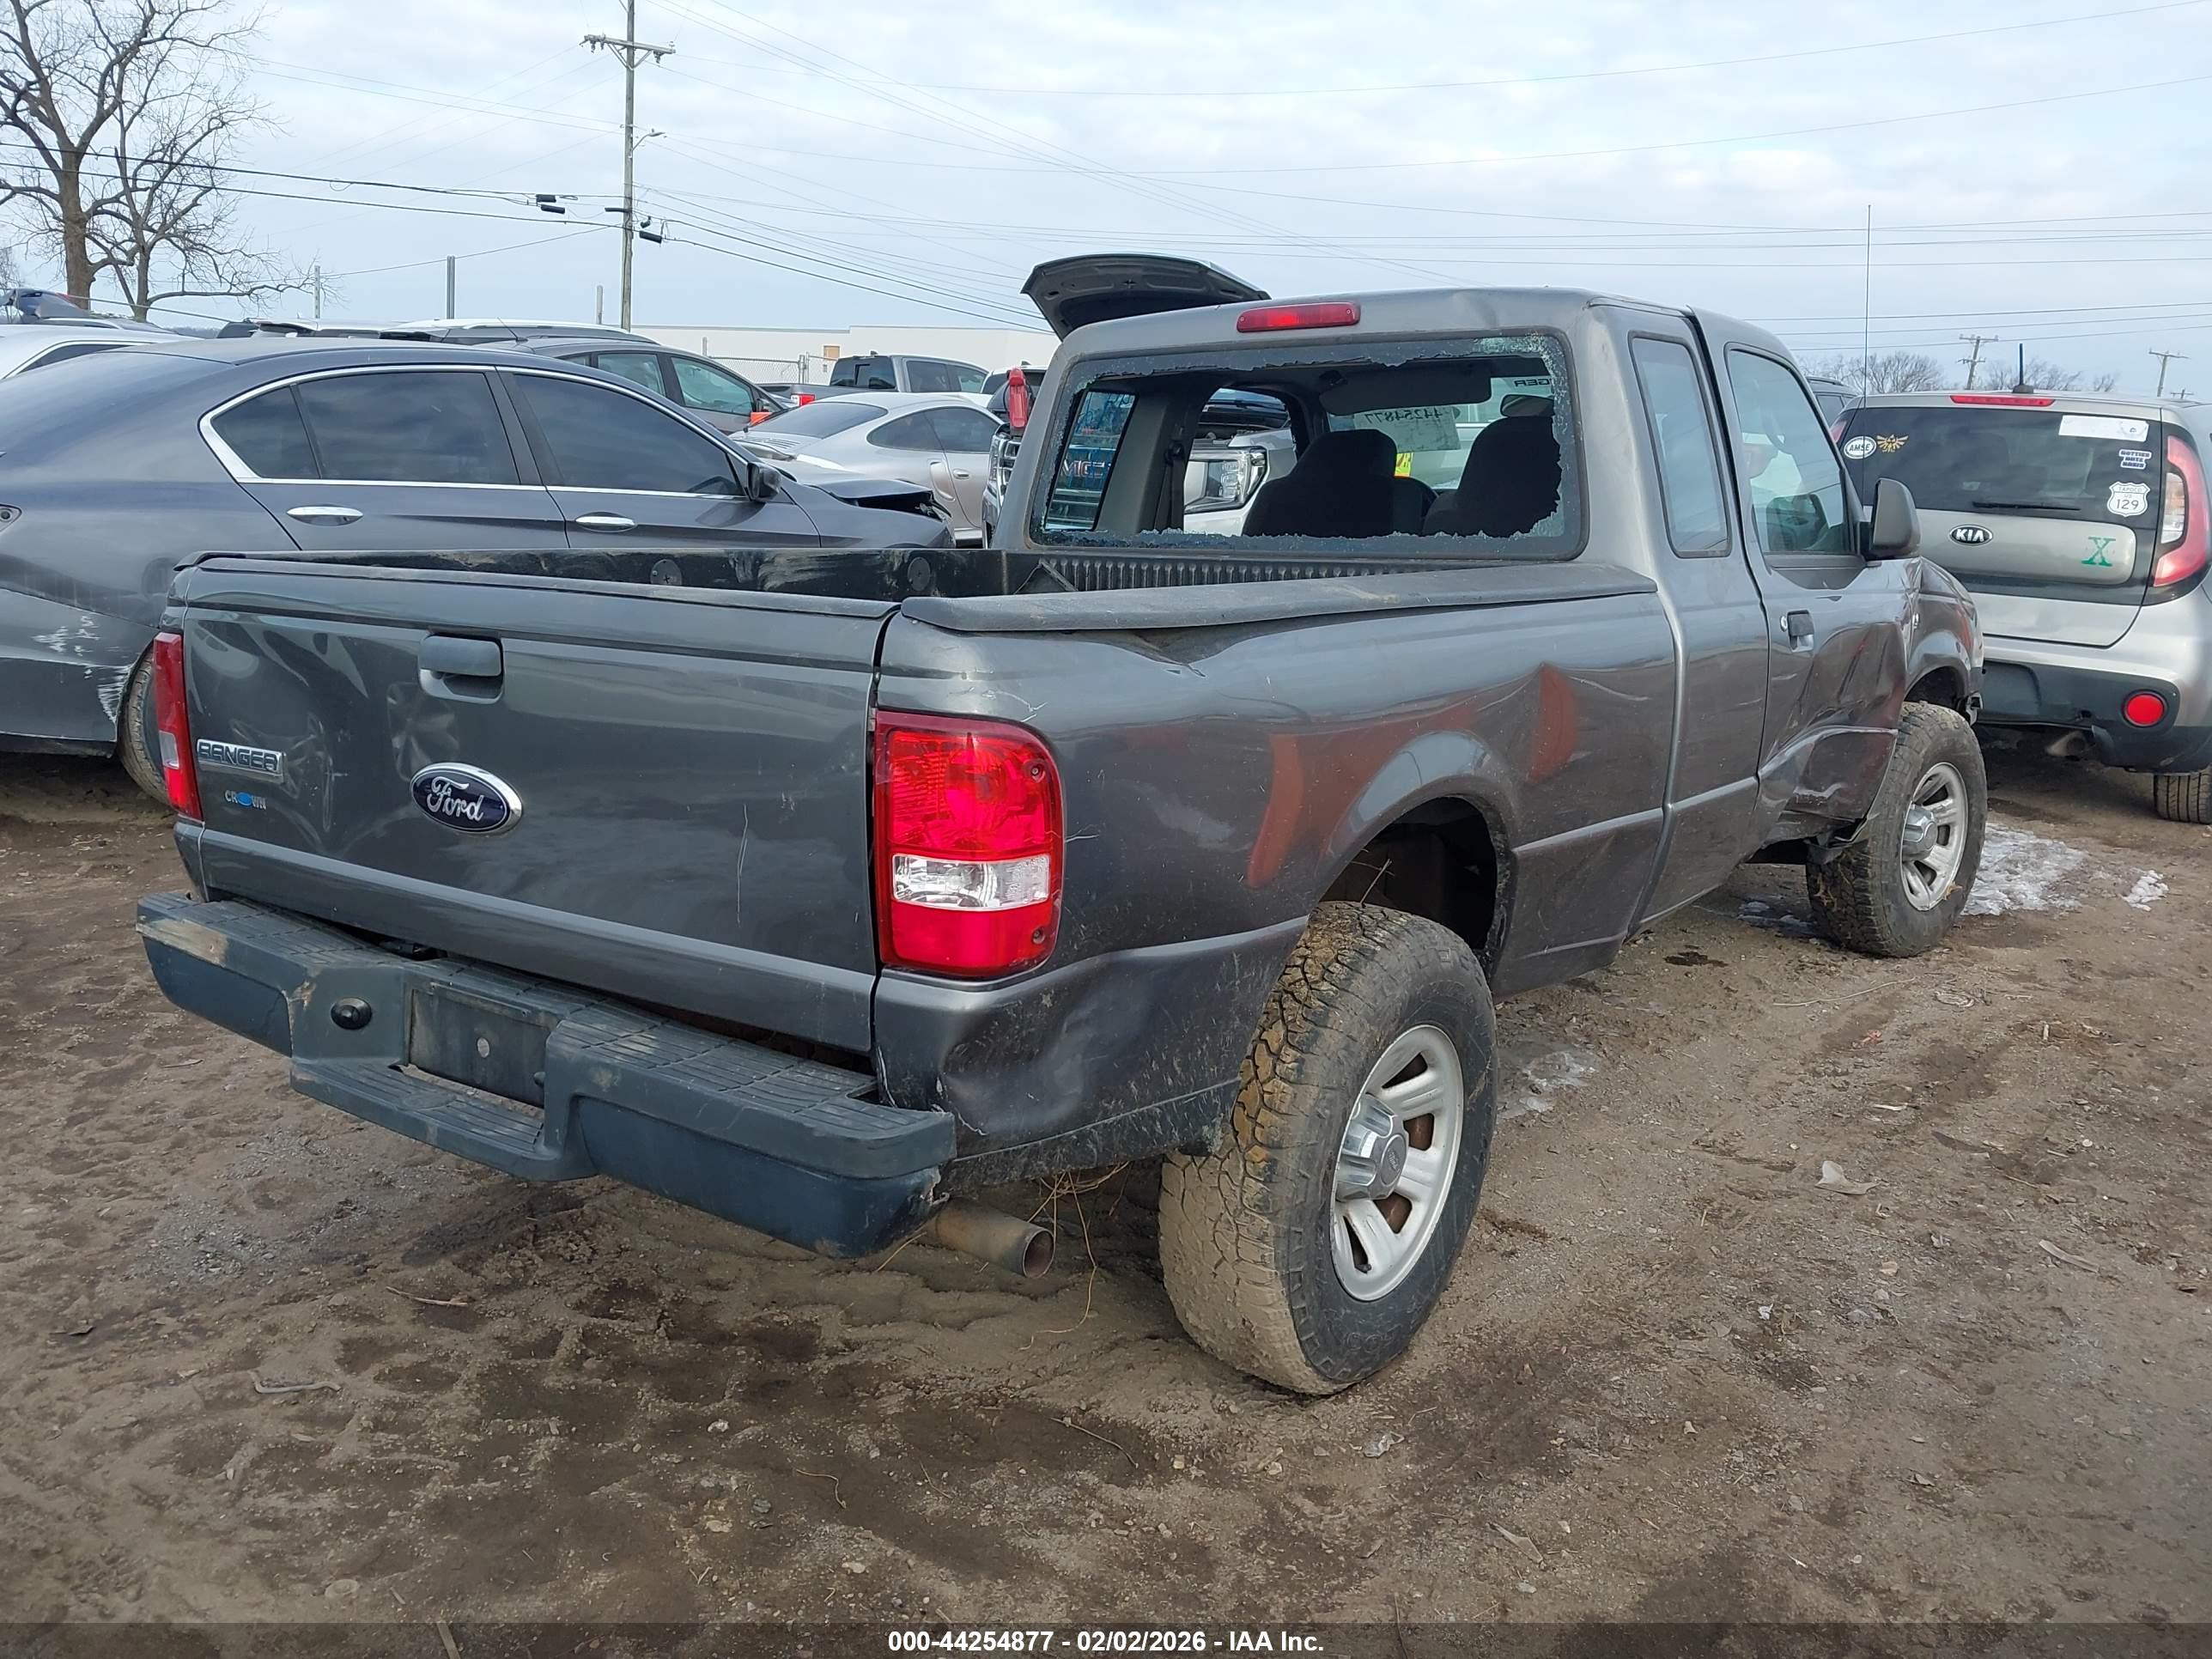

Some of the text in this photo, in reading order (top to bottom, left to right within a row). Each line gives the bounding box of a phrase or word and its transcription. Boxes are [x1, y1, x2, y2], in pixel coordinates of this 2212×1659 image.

[2117, 499, 2139, 510] 129
[1956, 528, 1984, 542] KIA
[2081, 536, 2117, 567] X
[198, 741, 278, 772] RANGER
[426, 775, 484, 822] Ford
